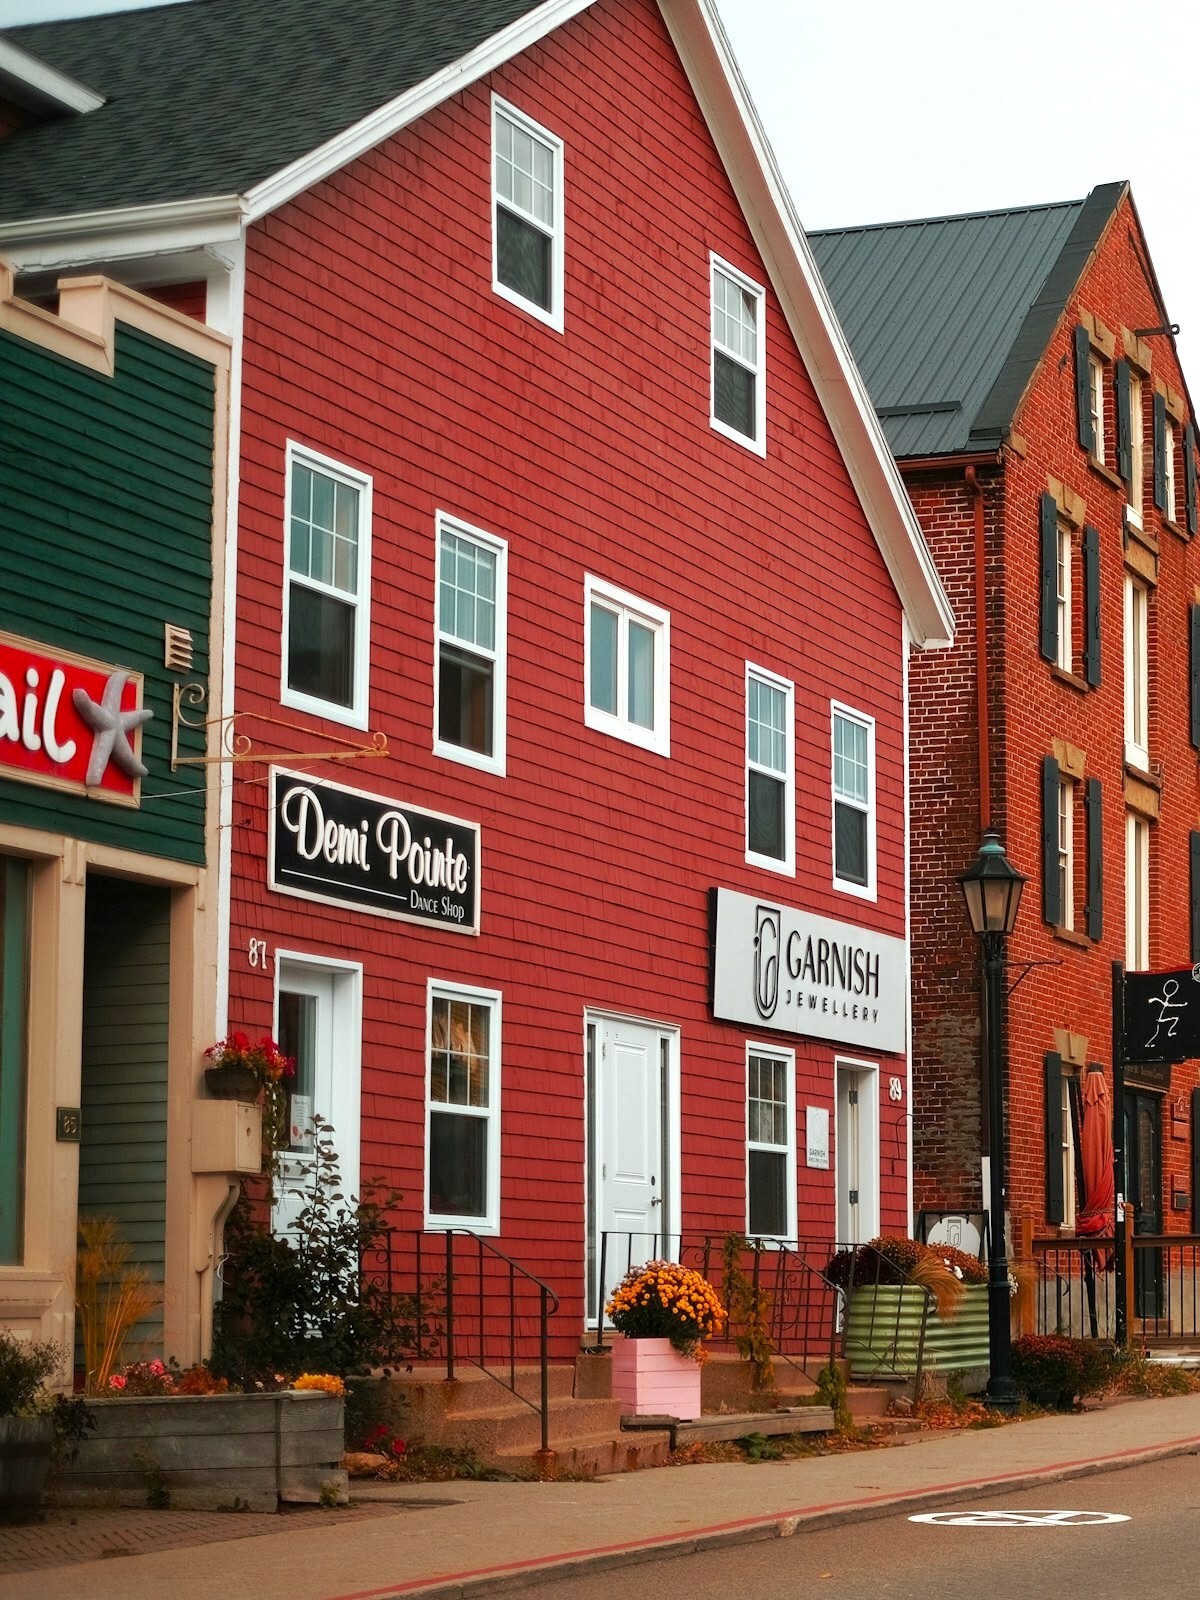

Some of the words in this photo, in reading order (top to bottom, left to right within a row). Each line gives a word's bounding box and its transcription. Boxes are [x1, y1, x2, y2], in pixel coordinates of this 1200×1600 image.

[281, 786, 370, 872] Demi
[375, 811, 468, 894] Pointe
[249, 937, 267, 970] 87
[786, 930, 879, 999] GARNISH
[786, 989, 879, 1024] JEWELLERY
[889, 1076, 902, 1101] 89
[63, 1115, 77, 1134] 85
